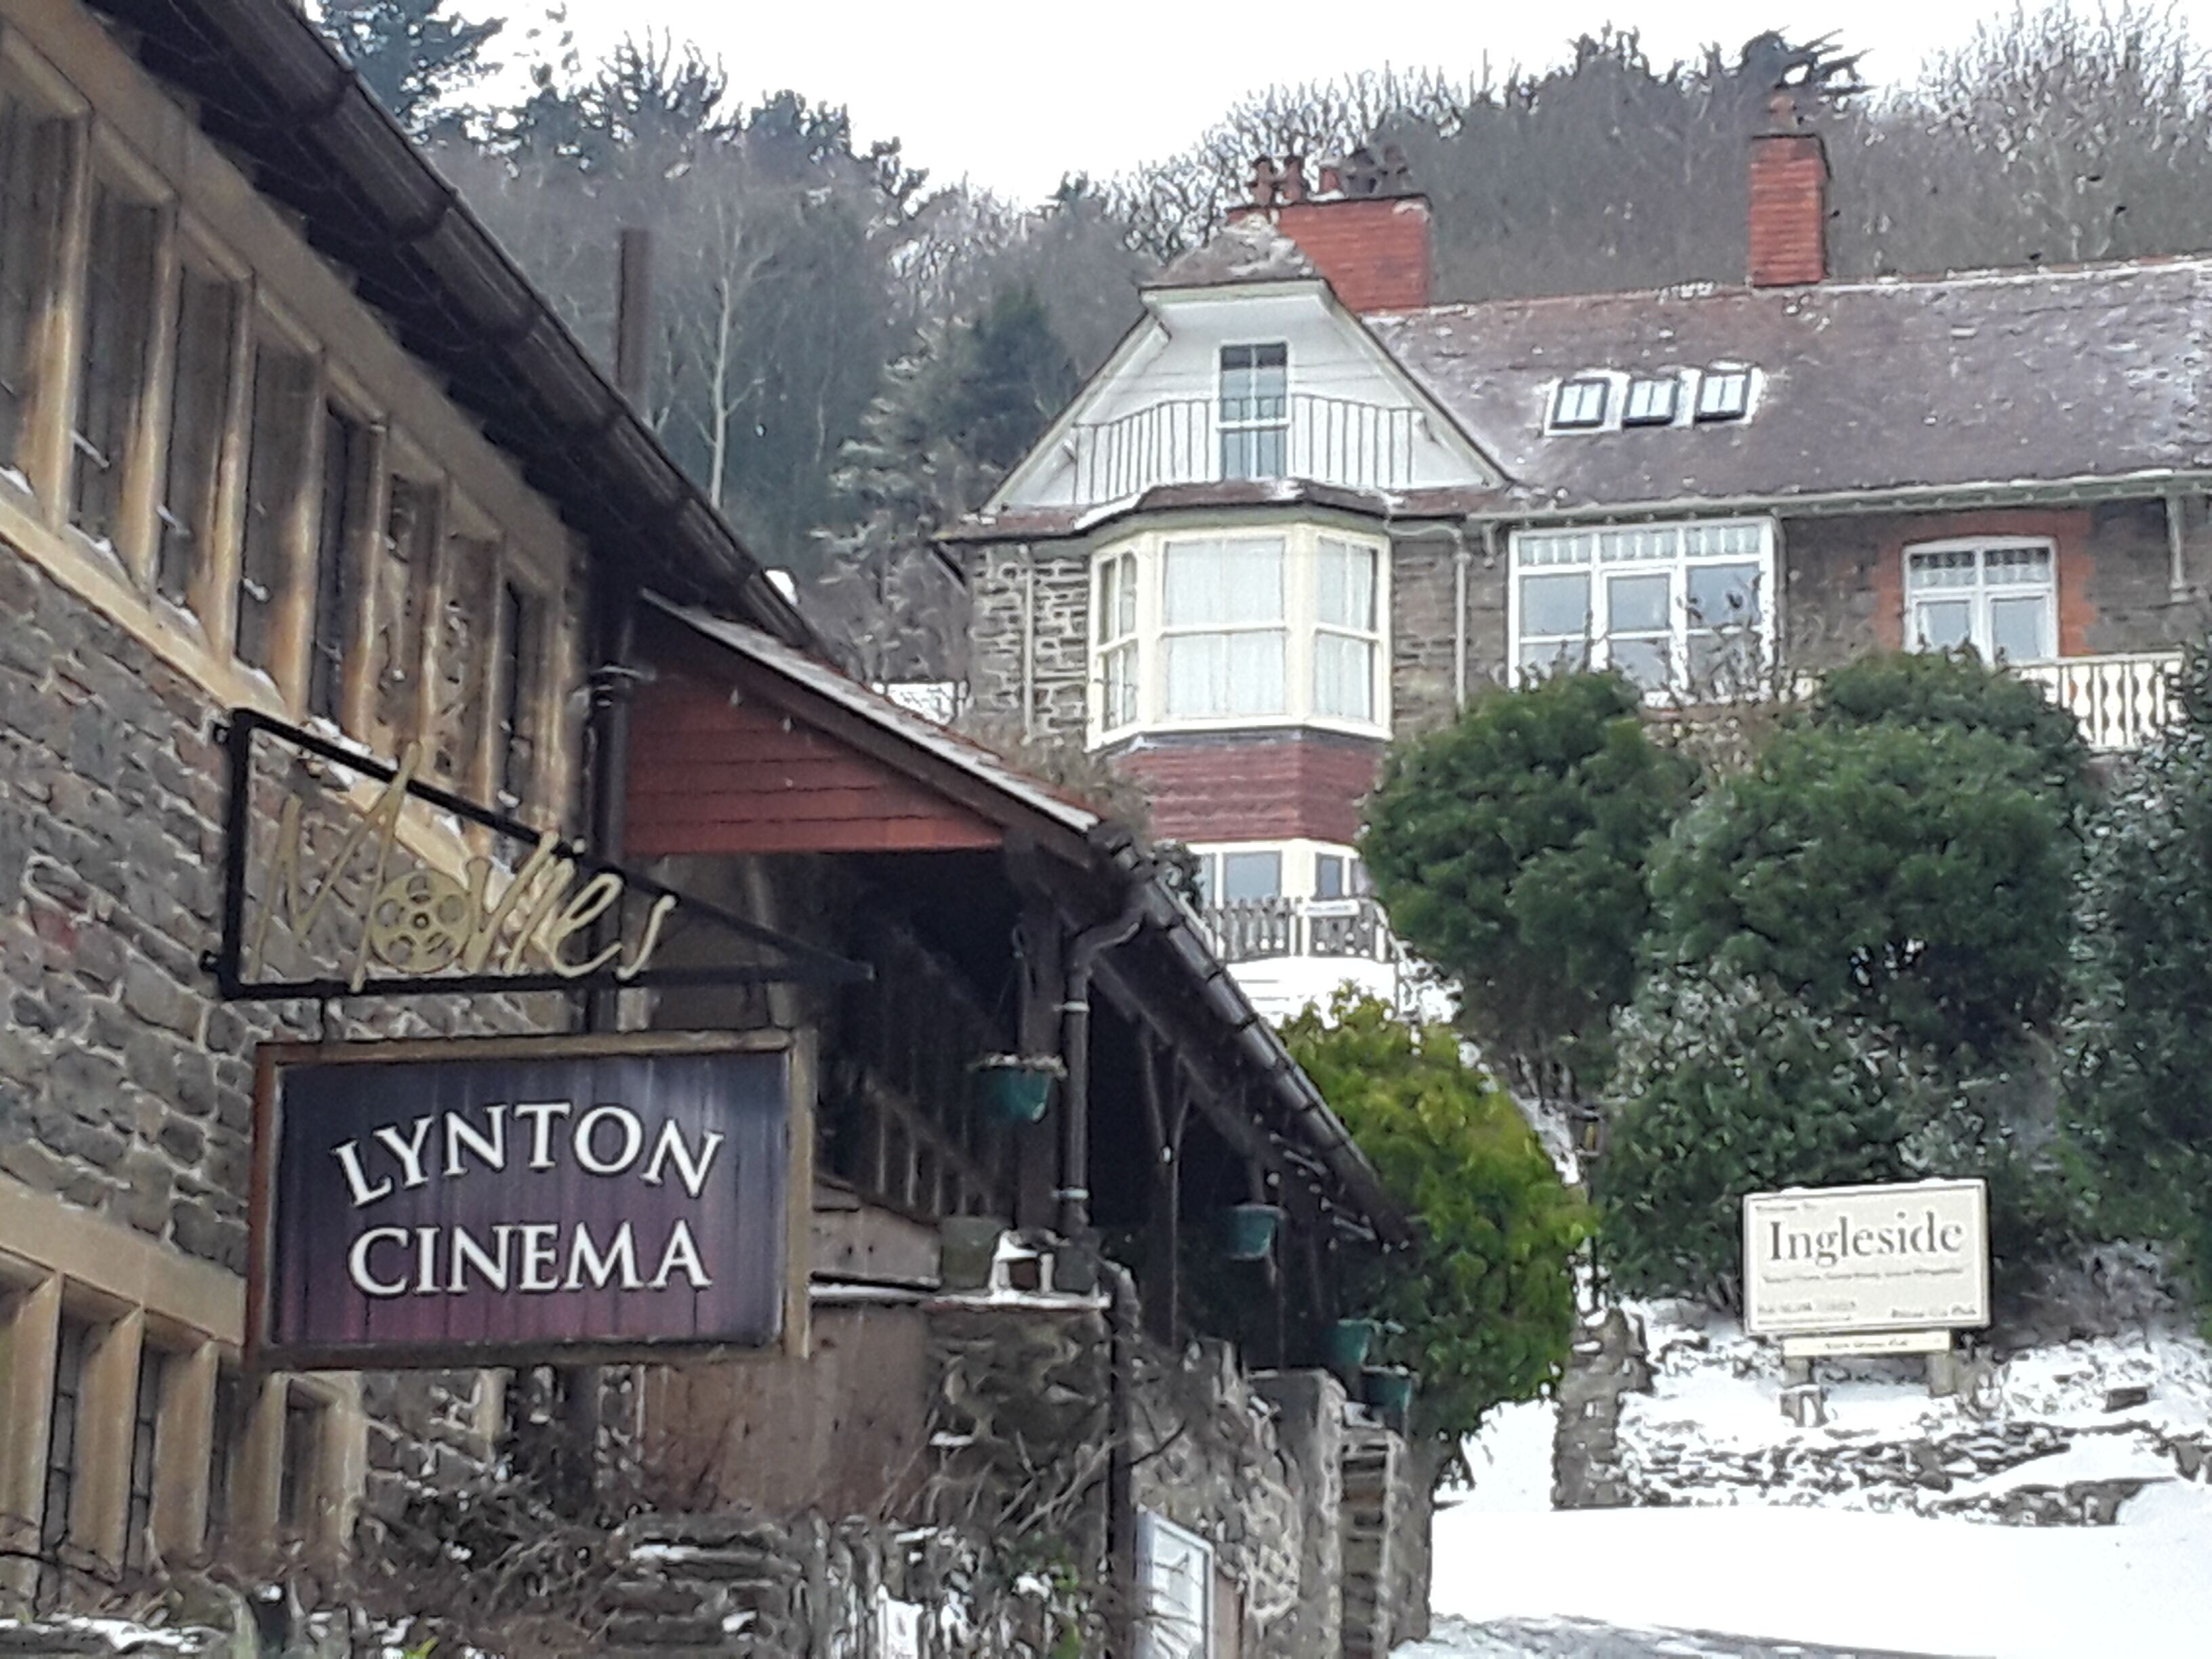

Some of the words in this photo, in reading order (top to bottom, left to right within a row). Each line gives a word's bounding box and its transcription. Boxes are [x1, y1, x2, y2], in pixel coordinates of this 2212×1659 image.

[332, 1101, 723, 1208] LYNTON
[348, 1220, 712, 1297] CINEMA
[1770, 1210, 1962, 1267] Ingleside
